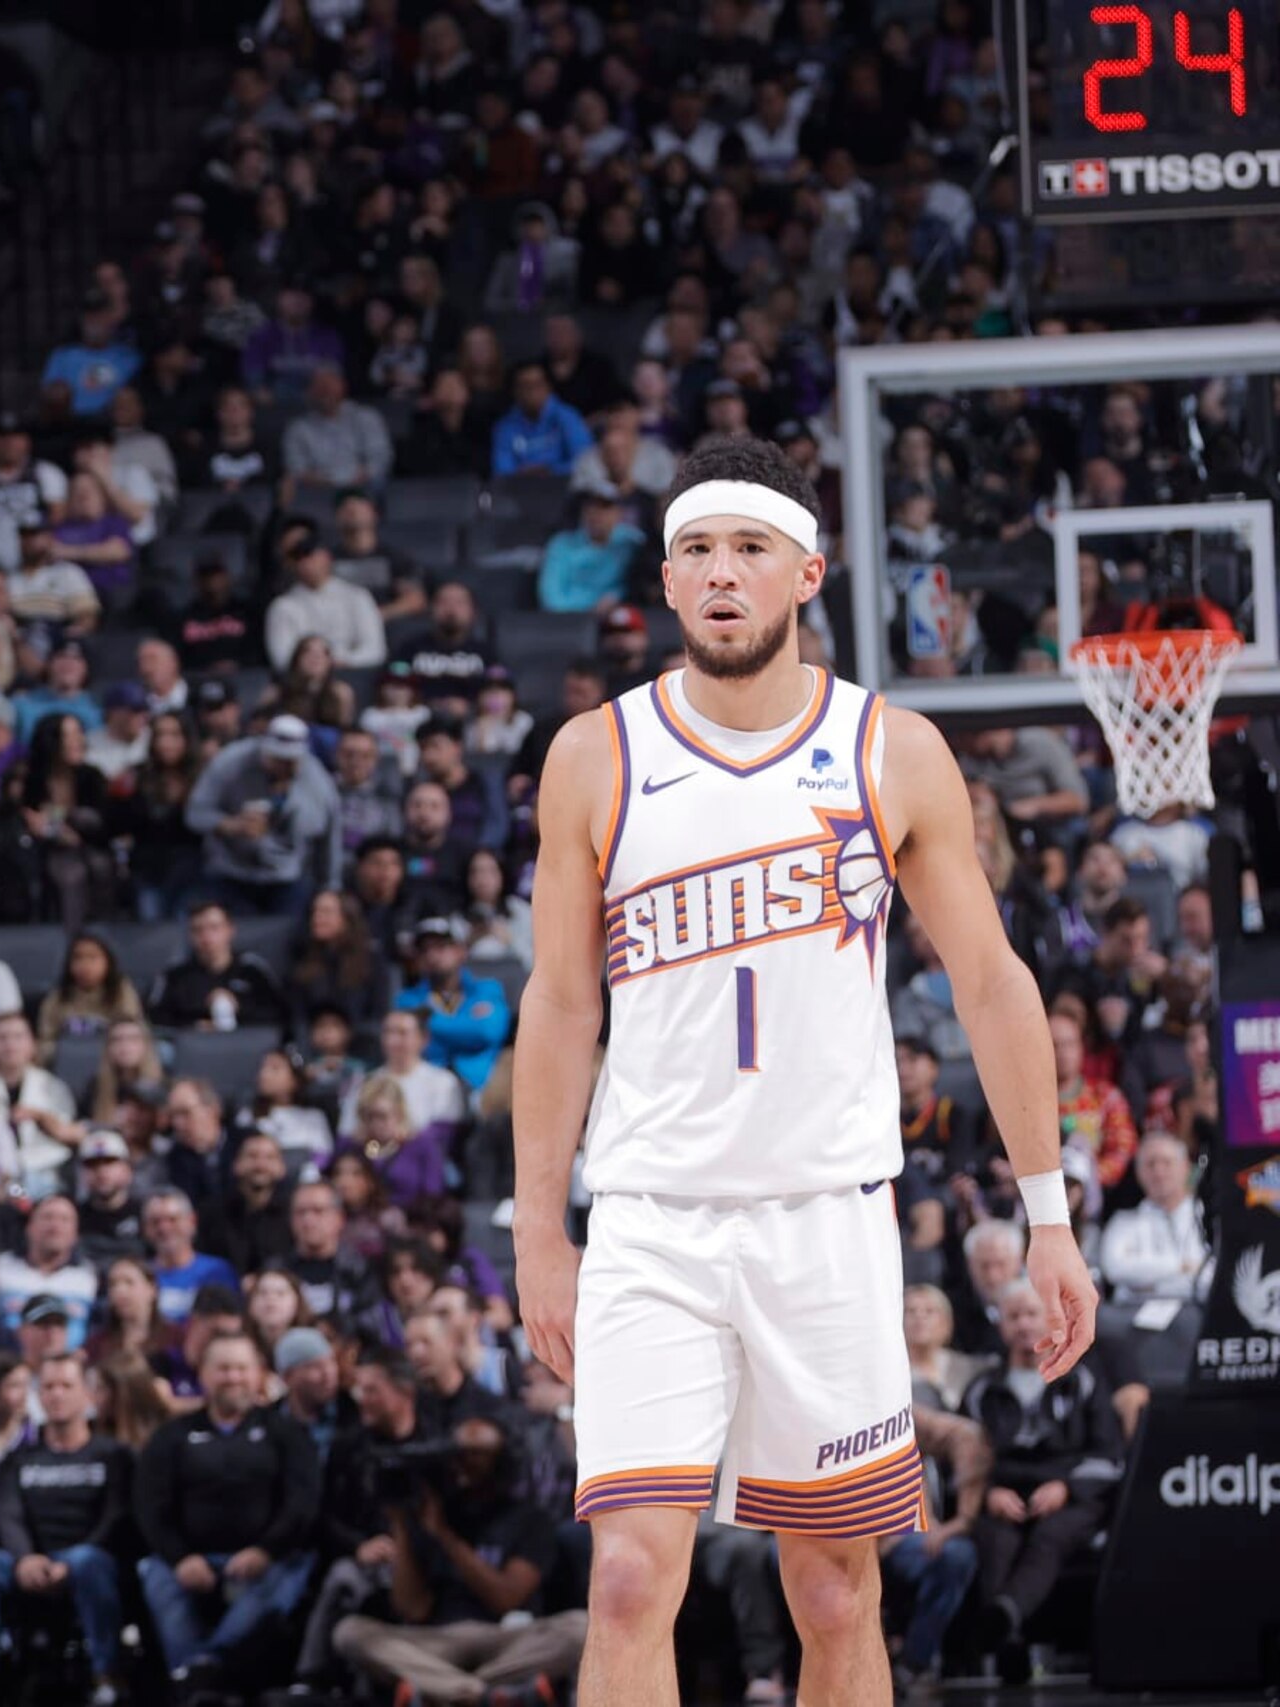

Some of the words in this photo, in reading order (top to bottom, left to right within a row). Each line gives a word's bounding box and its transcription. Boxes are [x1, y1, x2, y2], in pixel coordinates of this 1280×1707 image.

[1084, 5, 1246, 132] 24
[1109, 151, 1280, 195] TISSOT
[797, 777, 849, 791] PayPal
[623, 849, 825, 973] SUNS
[734, 966, 761, 1073] 1
[816, 1403, 911, 1470] PHOENIX
